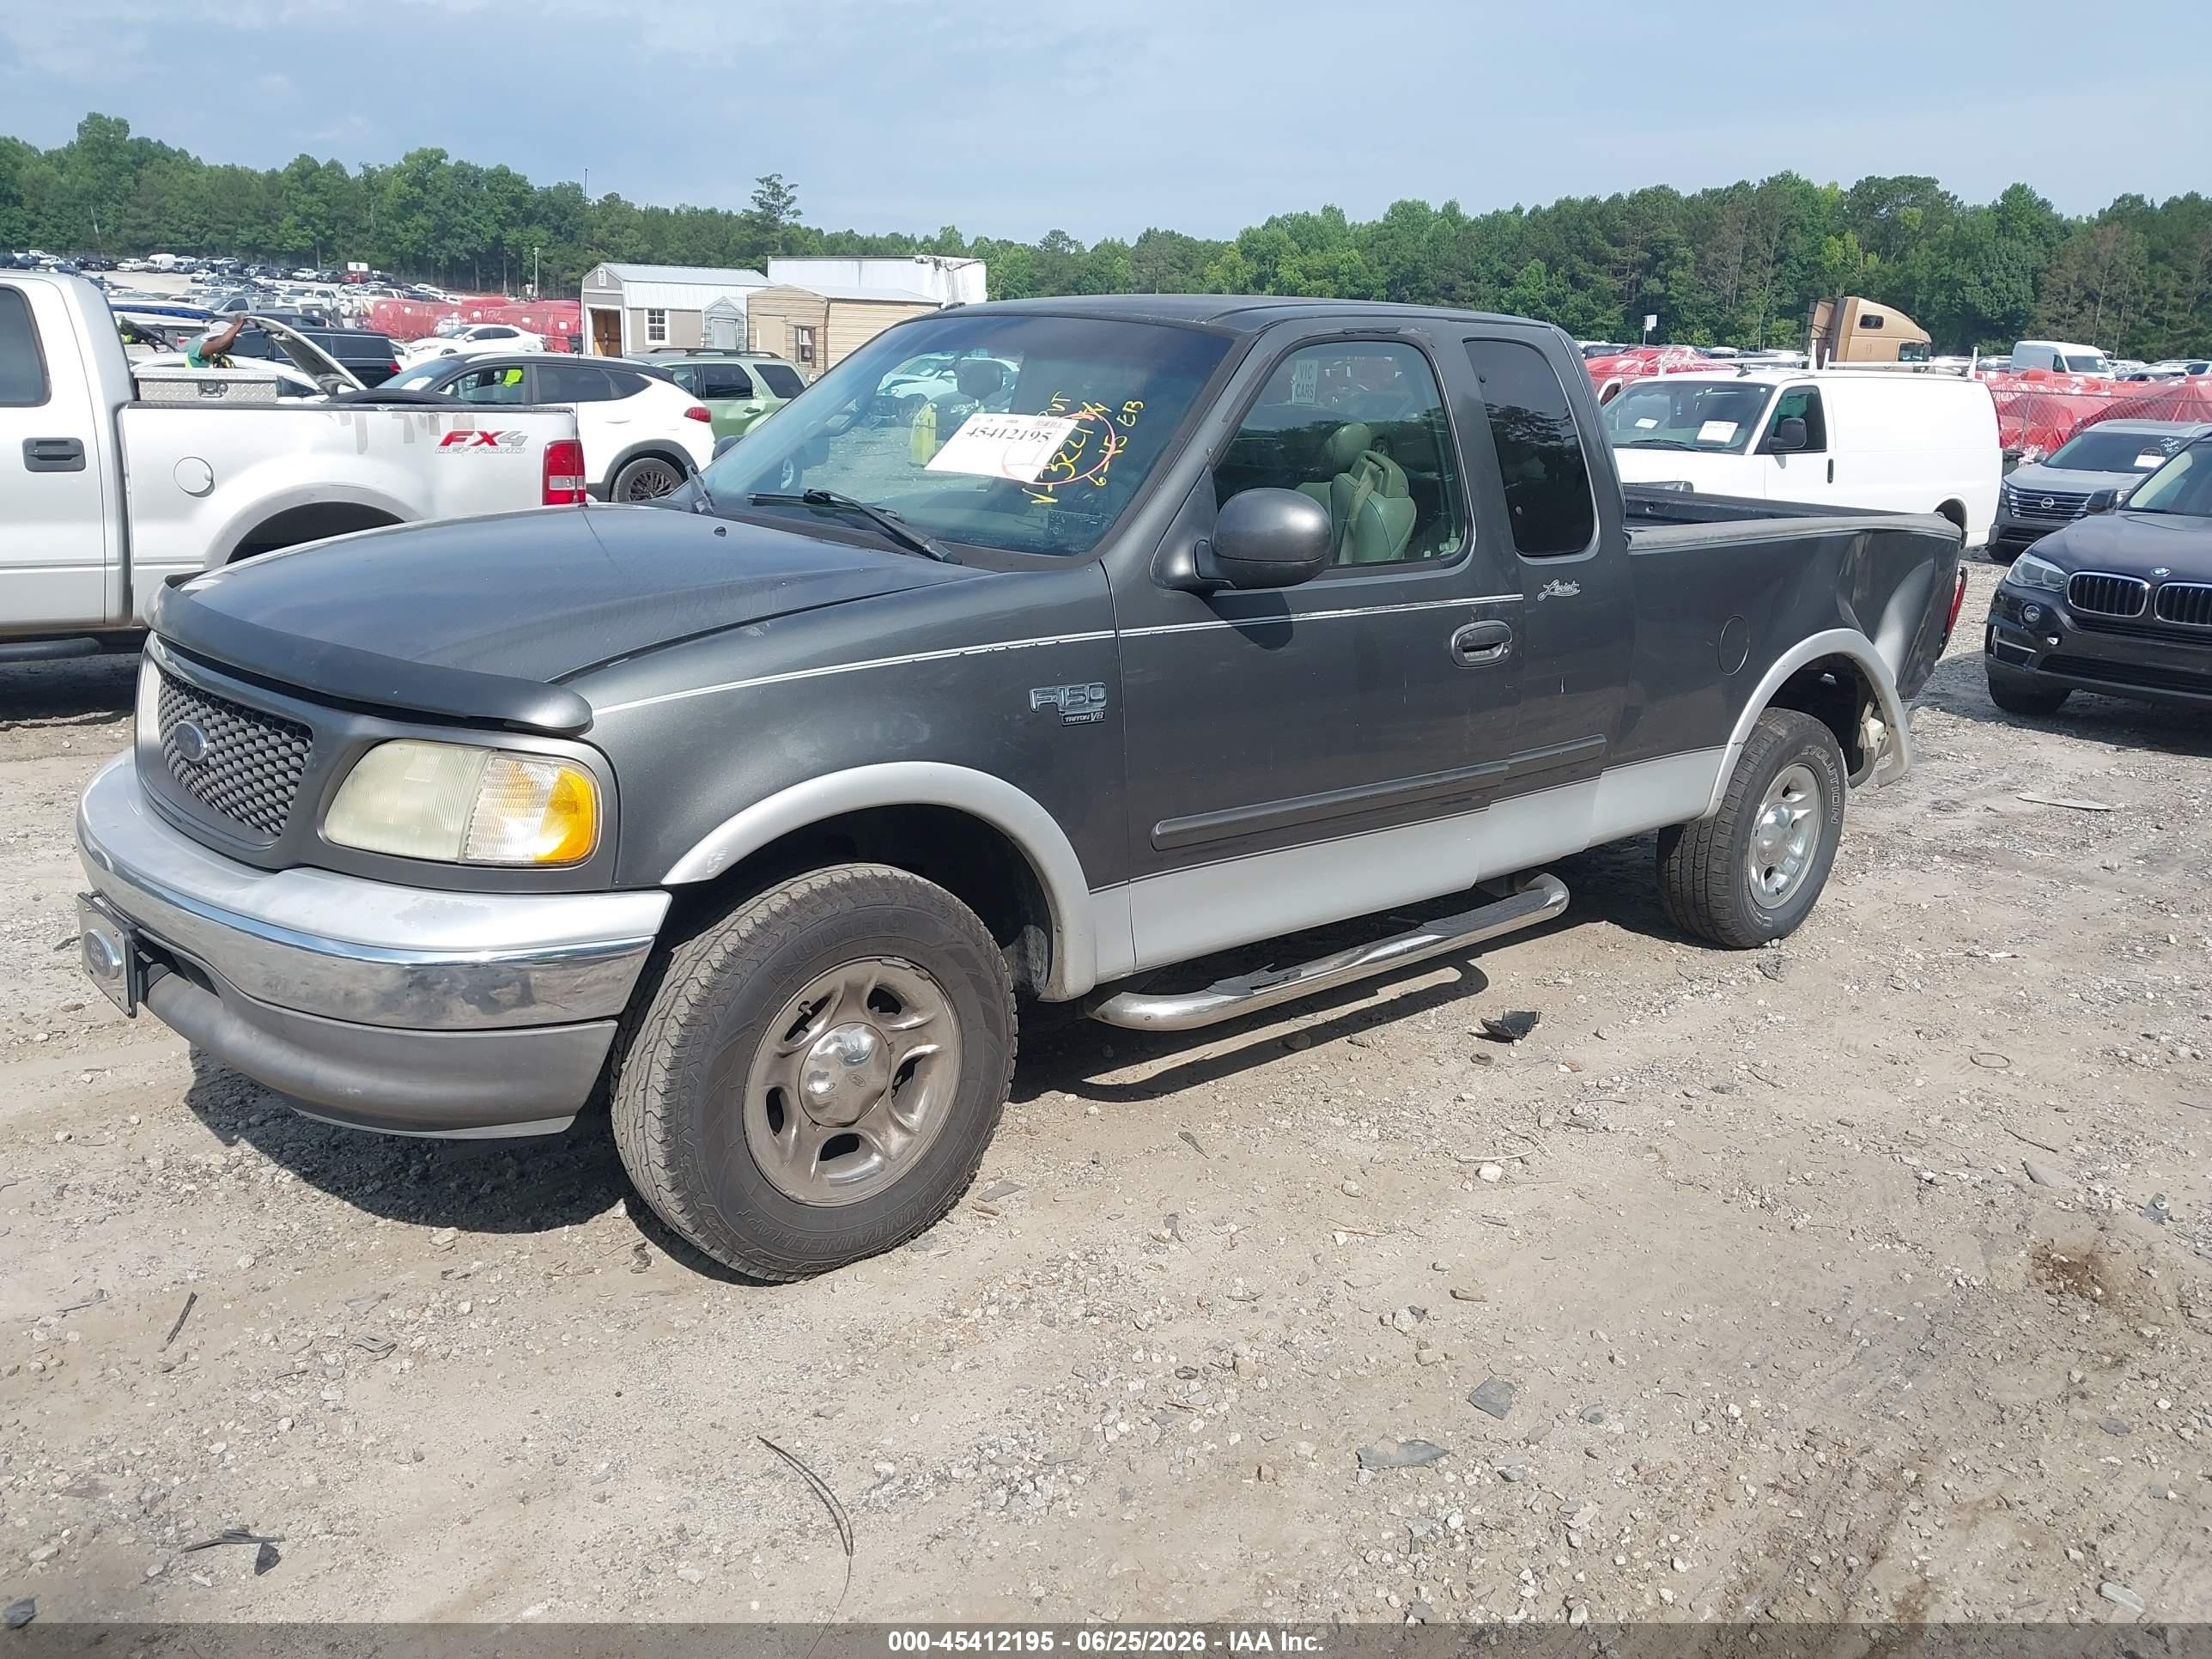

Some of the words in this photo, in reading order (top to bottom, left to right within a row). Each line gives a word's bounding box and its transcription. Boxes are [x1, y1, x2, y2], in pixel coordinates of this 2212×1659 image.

[1299, 364, 1313, 380] VIC
[1297, 384, 1314, 398] CARS
[438, 430, 529, 447] FX4
[966, 427, 1053, 443] 45412195
